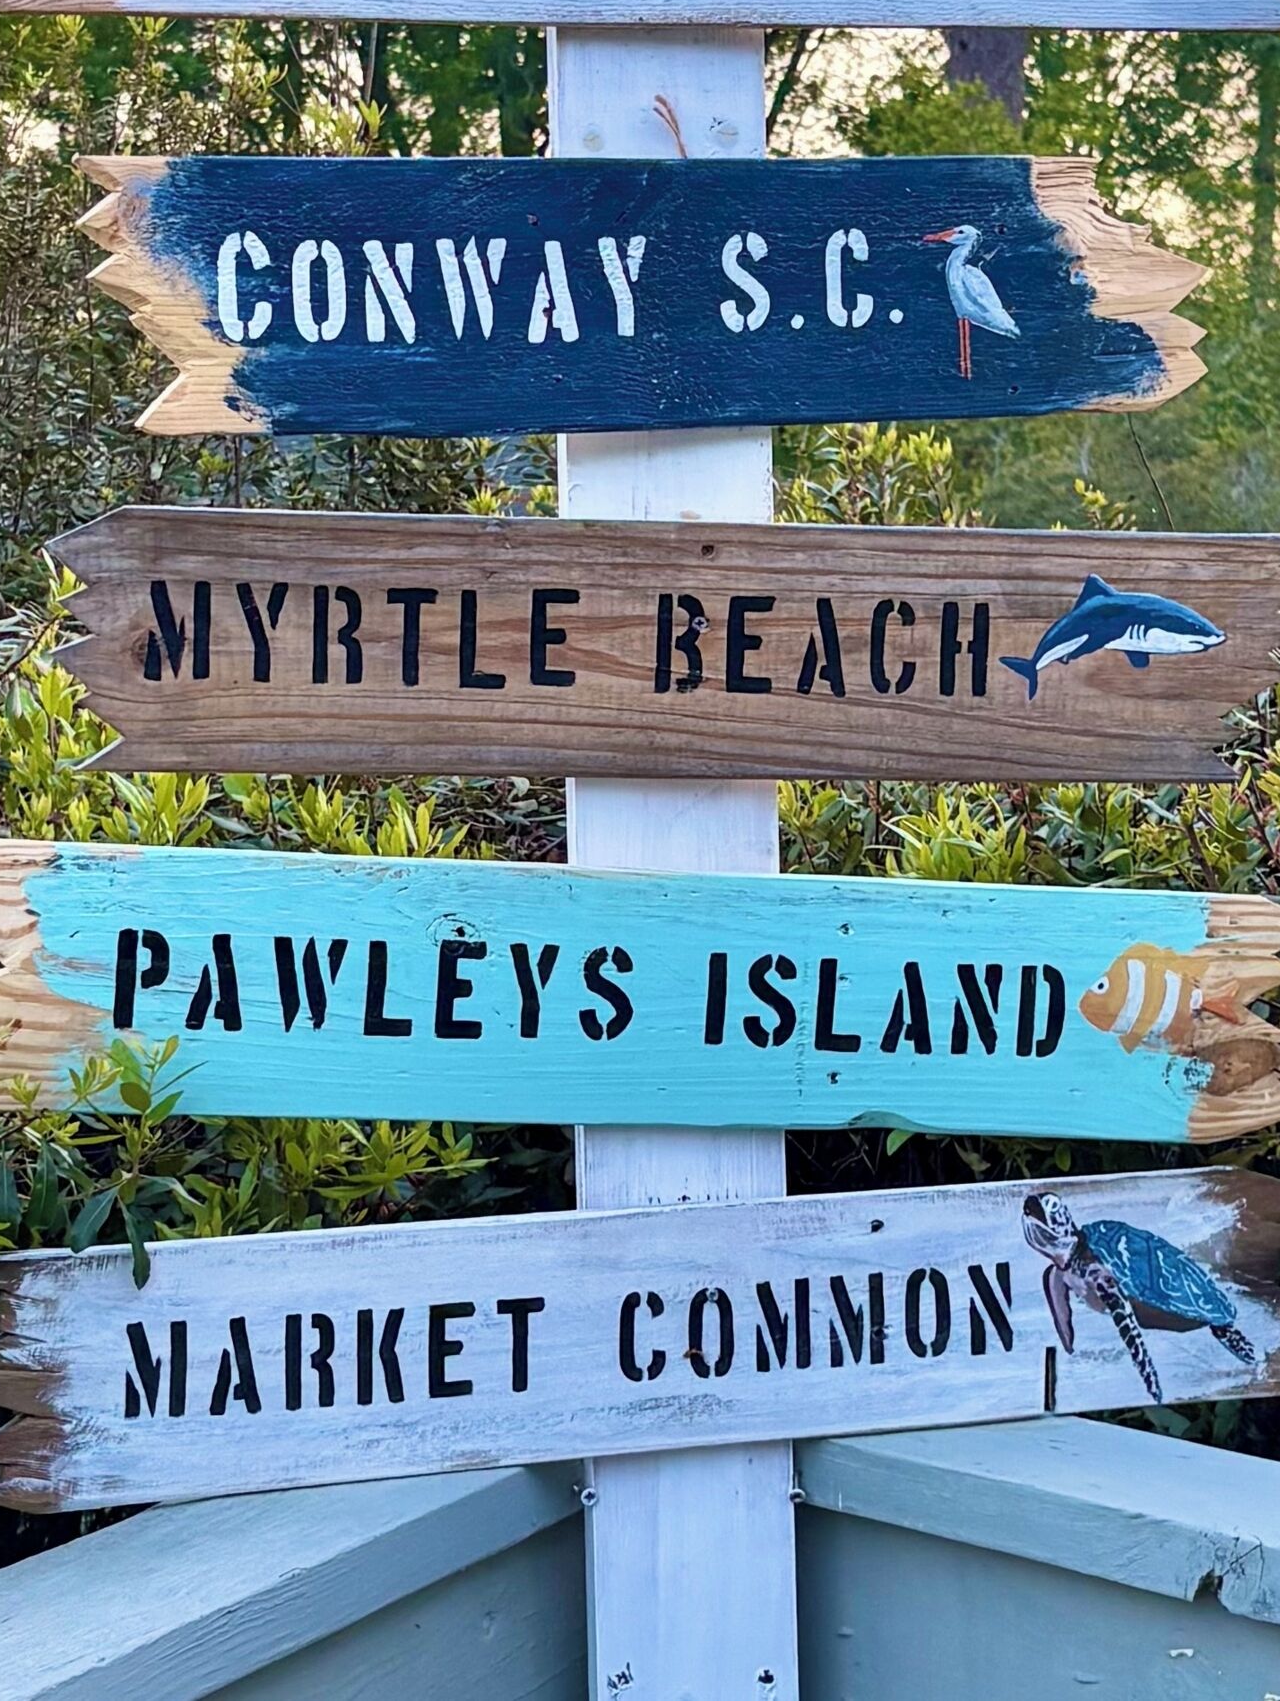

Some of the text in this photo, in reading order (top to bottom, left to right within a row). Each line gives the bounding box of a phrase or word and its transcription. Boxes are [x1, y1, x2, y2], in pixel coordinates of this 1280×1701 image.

[217, 228, 904, 343] CONWAY S.C.
[143, 580, 989, 697] MYRTLE BEACH
[113, 929, 1066, 1057] PAWLEYS ISLAND
[124, 1261, 1014, 1418] MARKET COMMON
